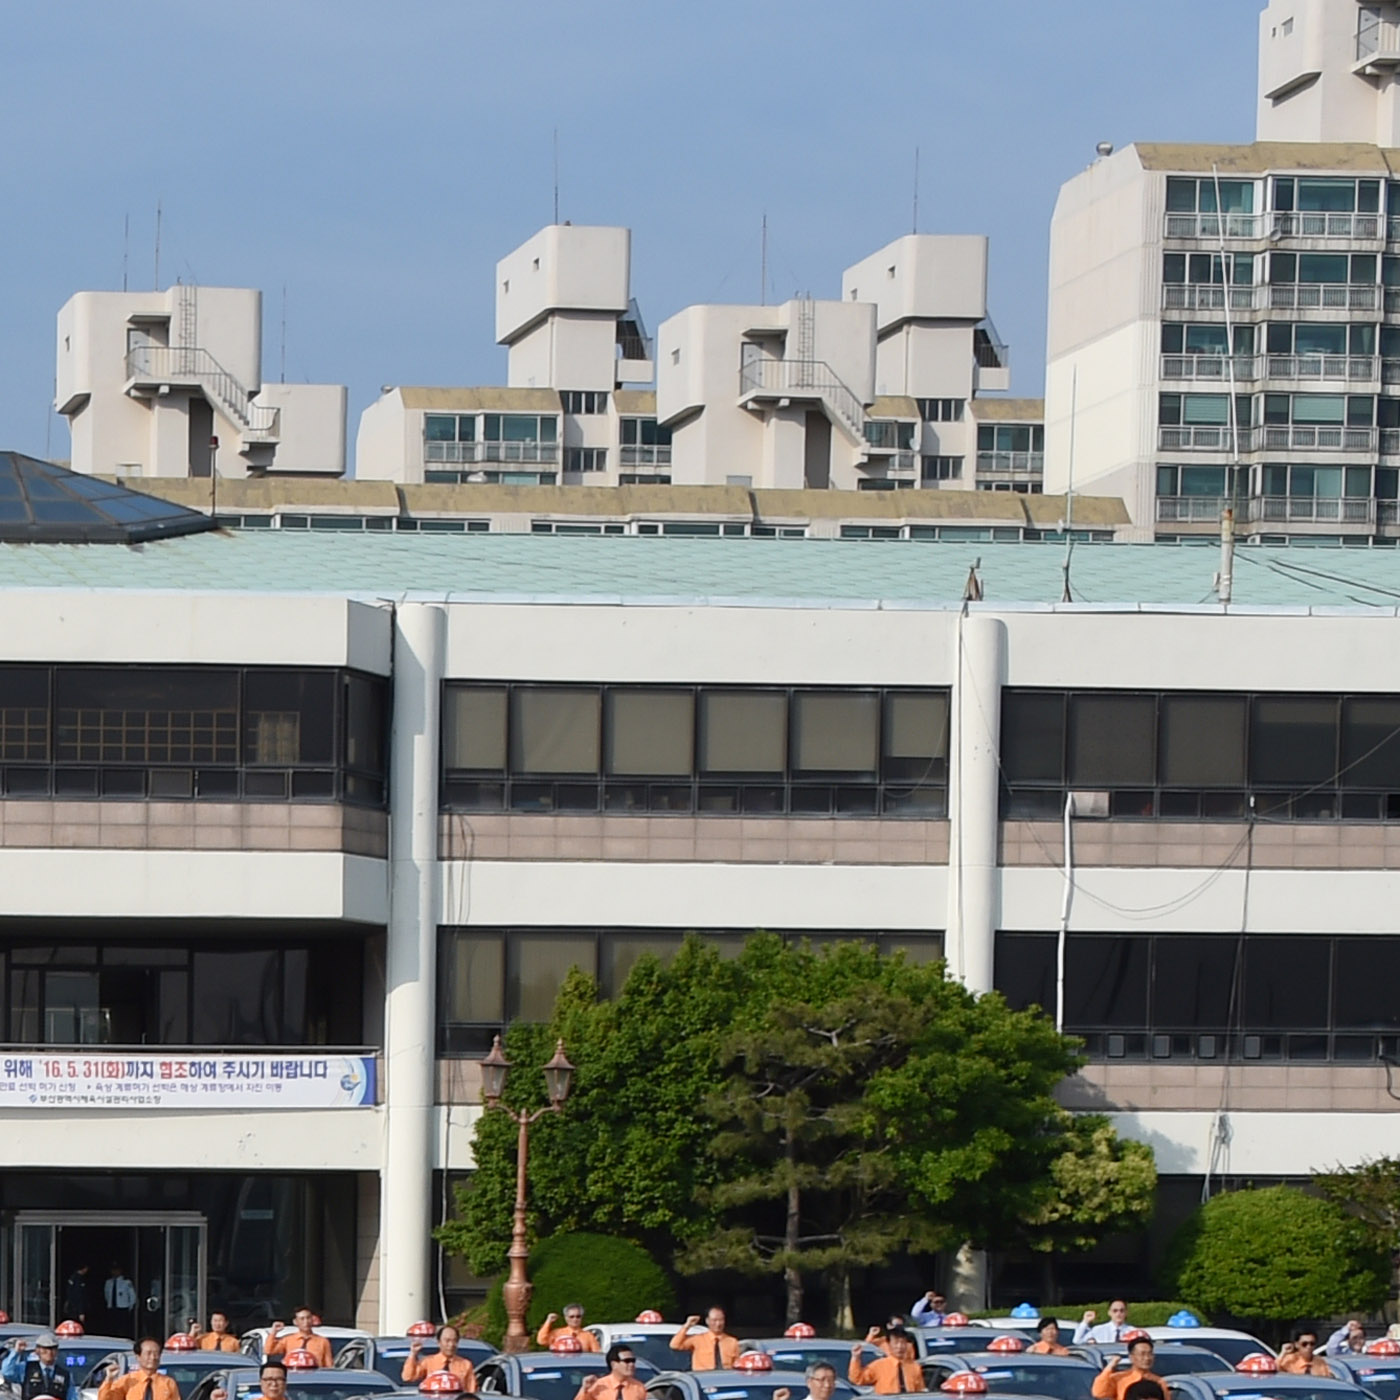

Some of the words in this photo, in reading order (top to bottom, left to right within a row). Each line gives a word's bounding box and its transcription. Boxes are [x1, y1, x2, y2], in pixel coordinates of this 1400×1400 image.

[4, 1059, 33, 1078] 위해
[83, 1061, 154, 1079] 31(화)까지
[159, 1061, 217, 1080] 협조하여
[222, 1061, 265, 1080] 주시기
[270, 1061, 328, 1080] 바랍니다
